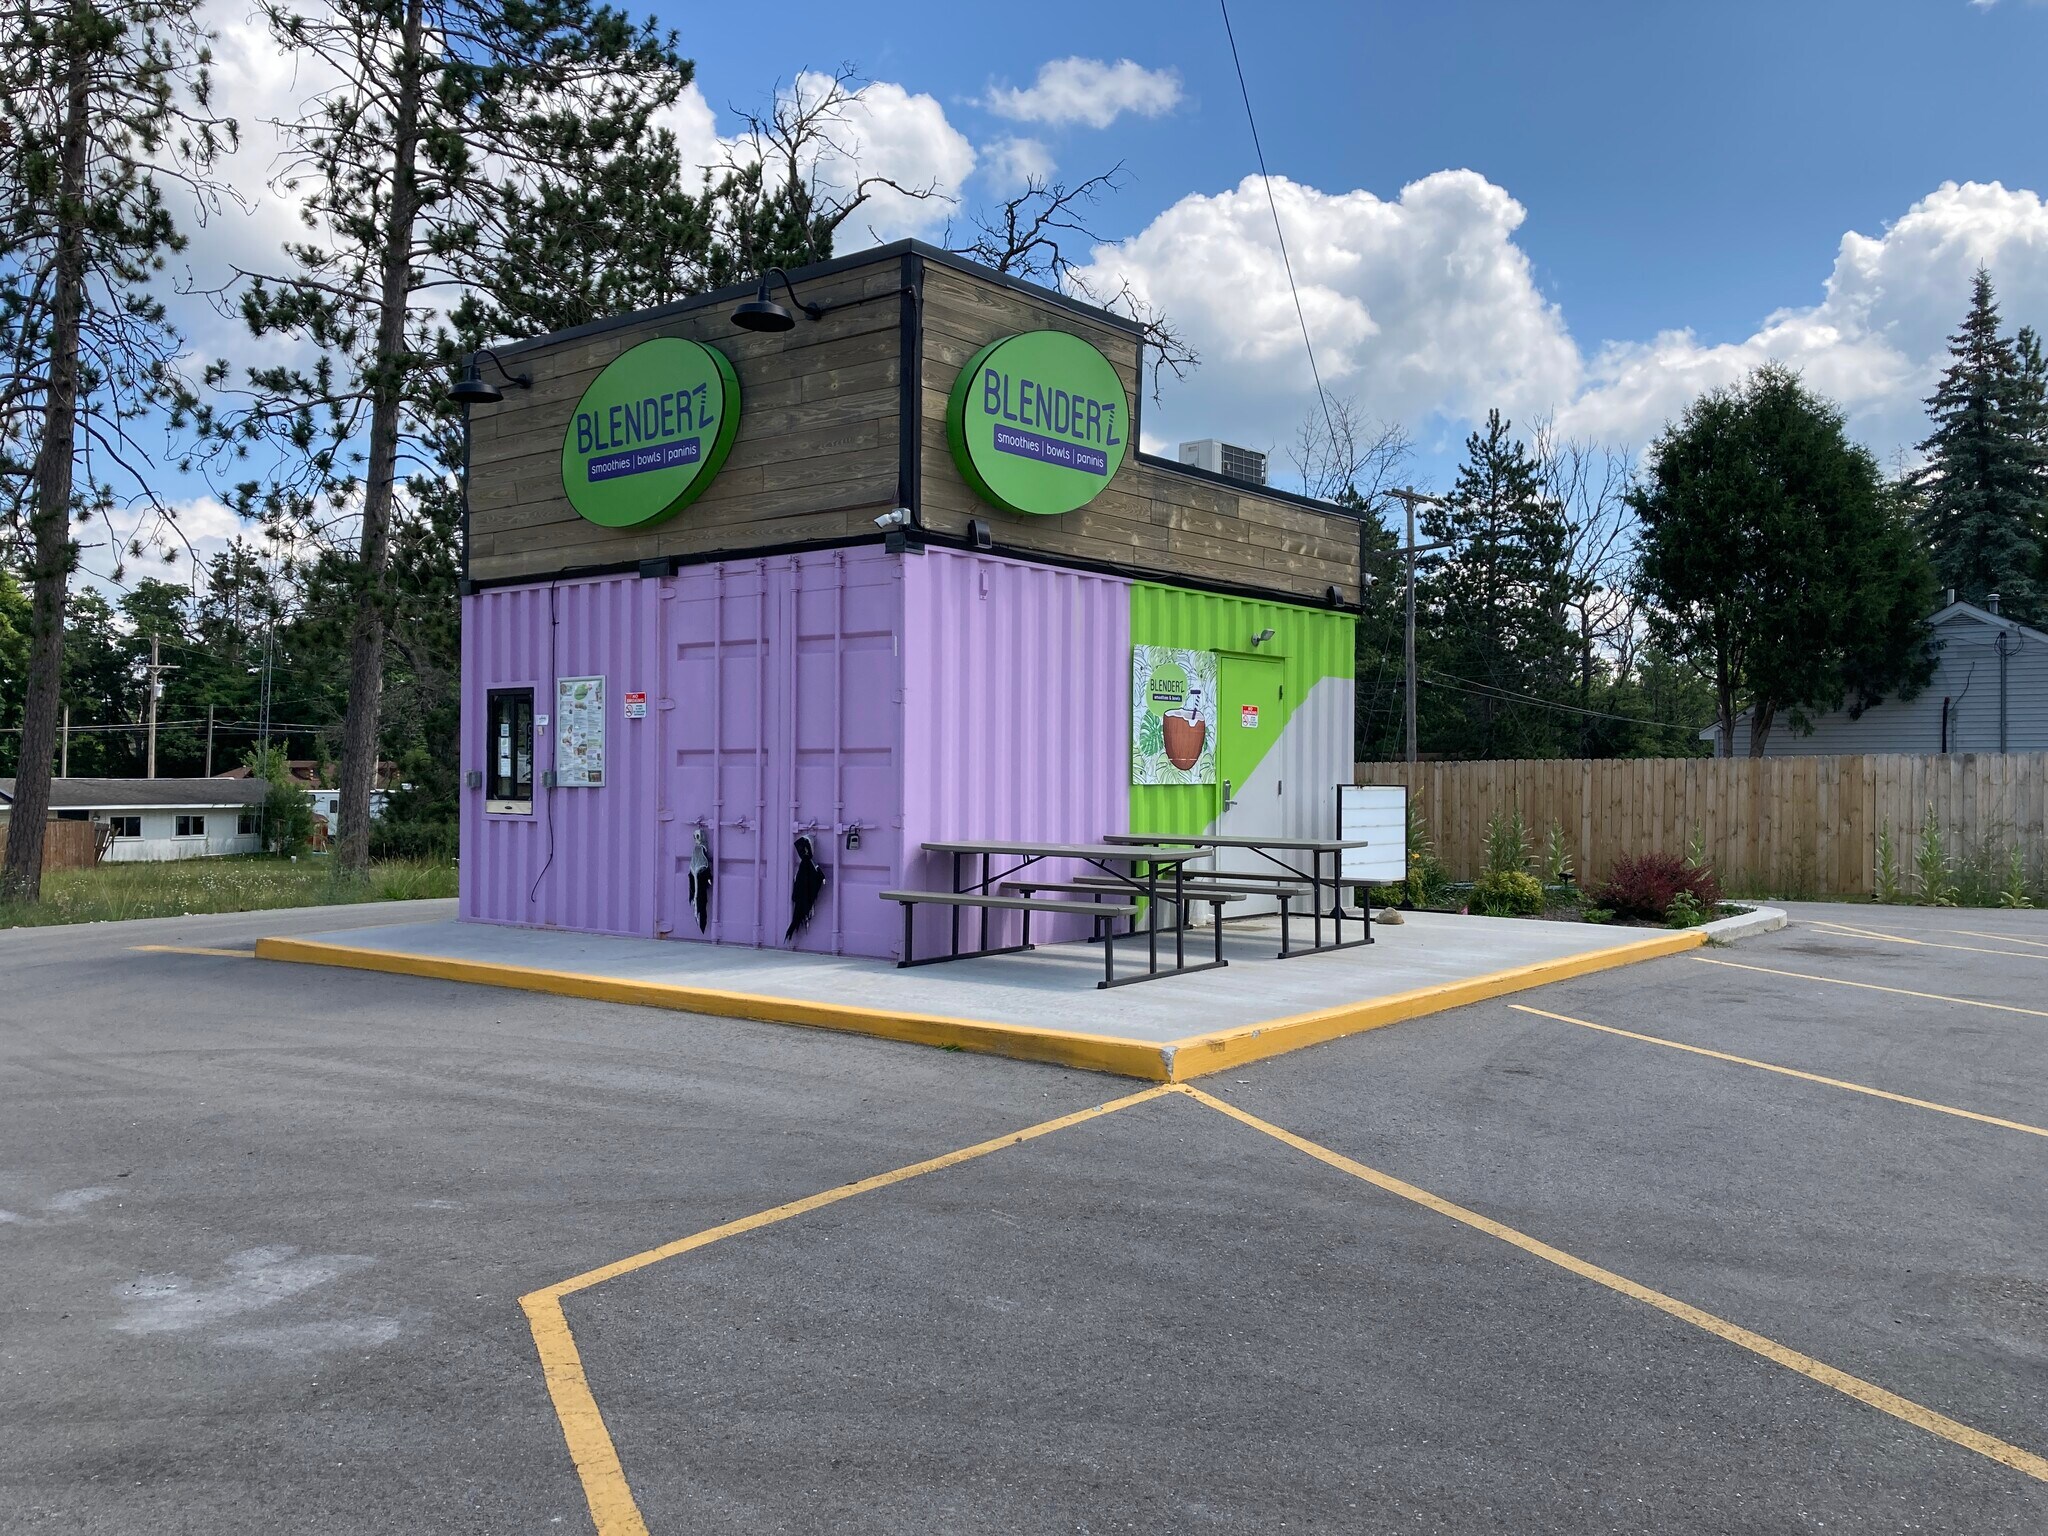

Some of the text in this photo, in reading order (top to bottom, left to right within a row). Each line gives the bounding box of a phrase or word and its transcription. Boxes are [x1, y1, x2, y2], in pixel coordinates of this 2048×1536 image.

[591, 444, 697, 475] smoothies bowls paninis
[997, 432, 1104, 468] smoothies bowls paninis
[1150, 678, 1185, 693] BLENDERZ
